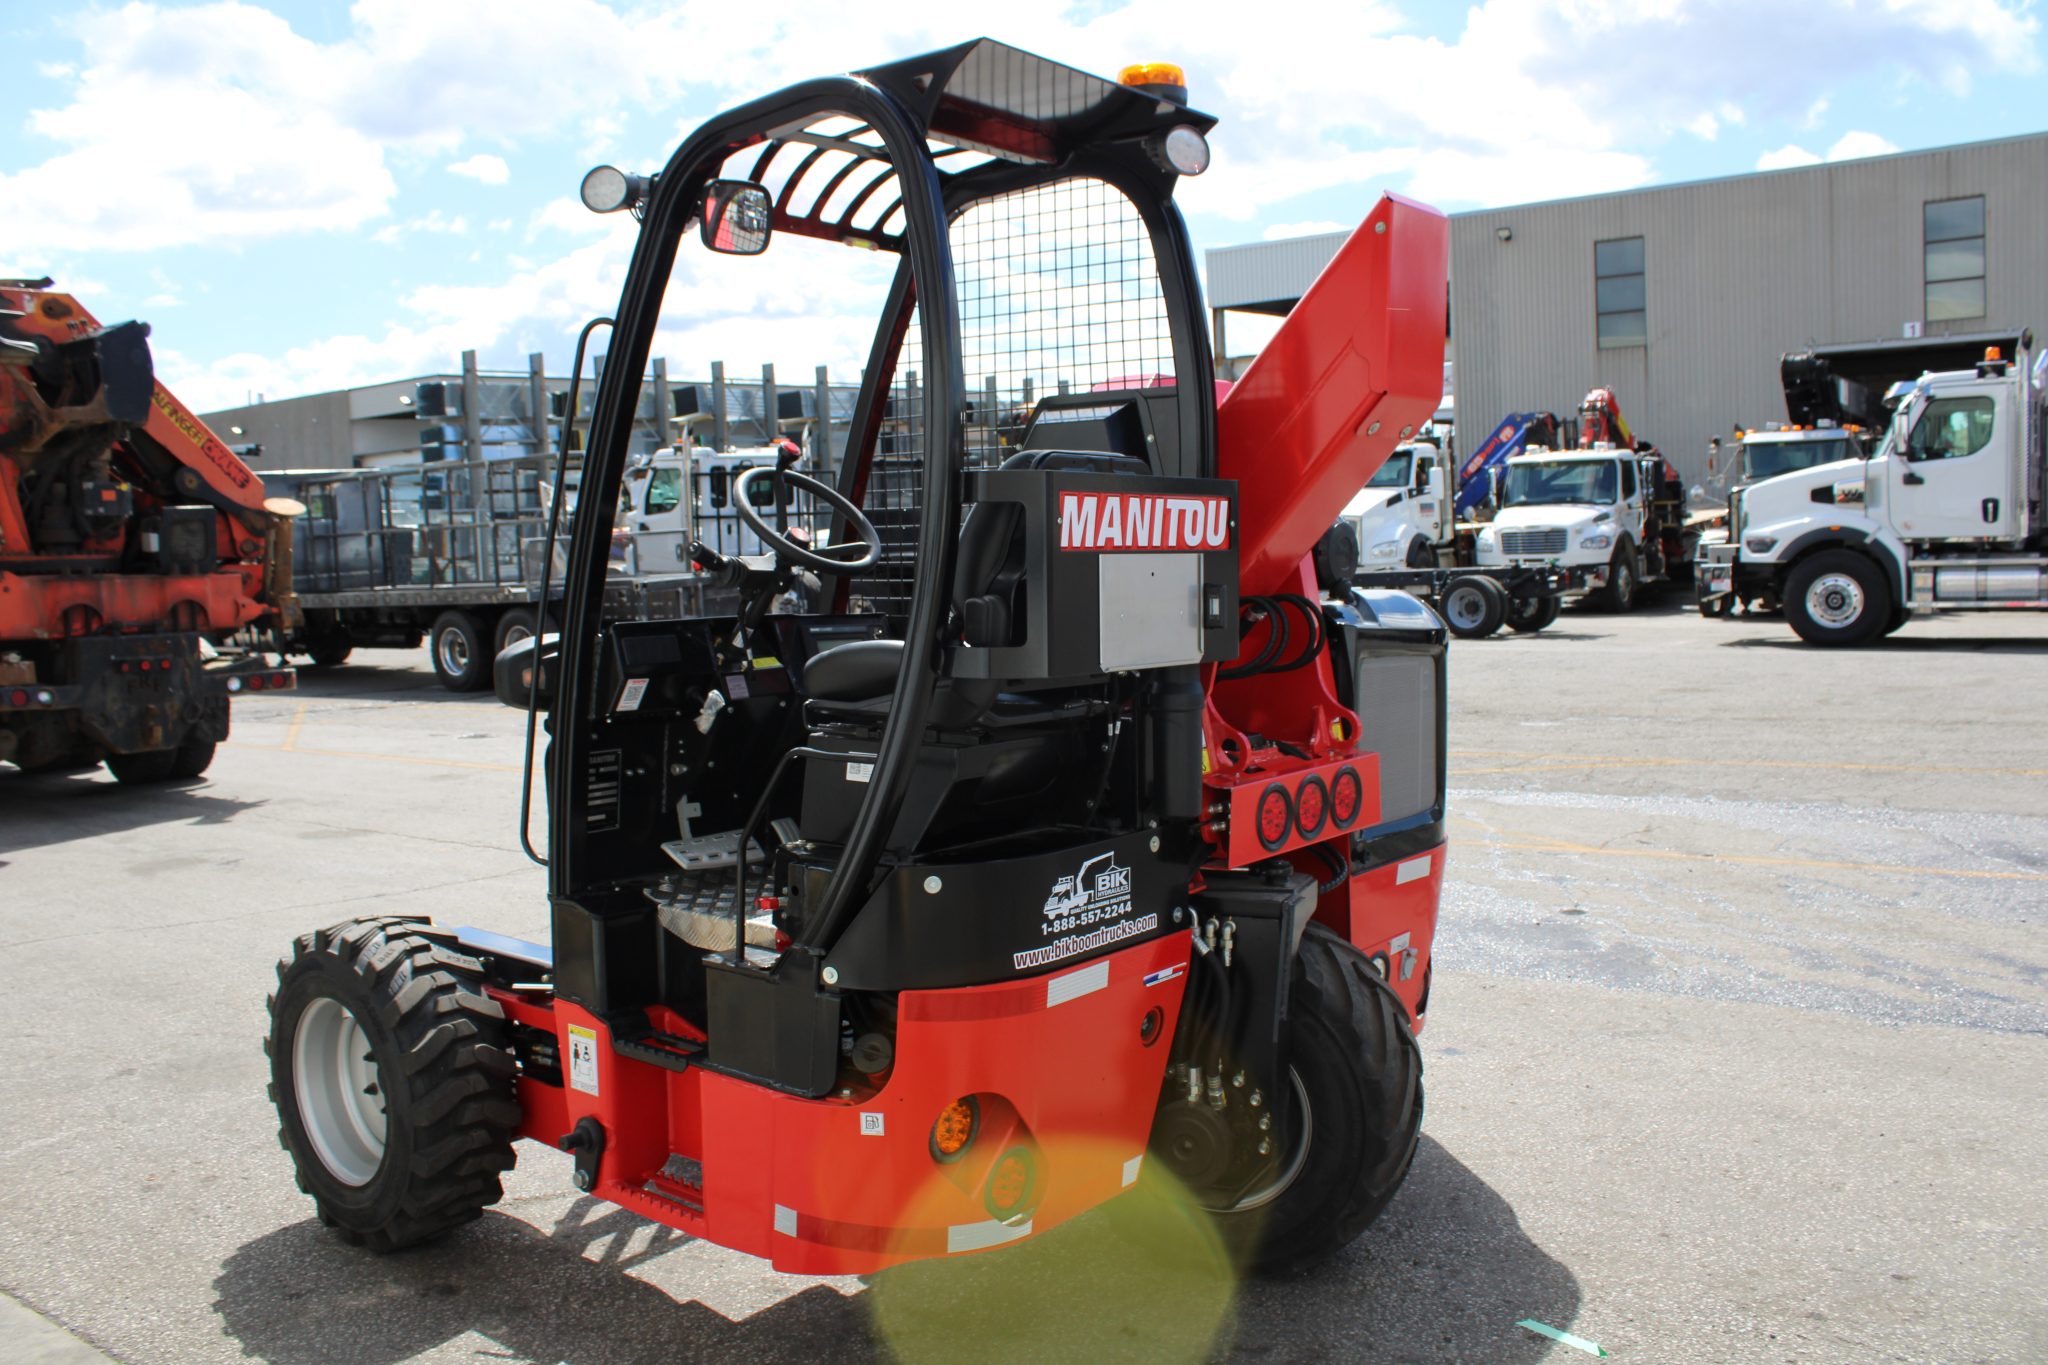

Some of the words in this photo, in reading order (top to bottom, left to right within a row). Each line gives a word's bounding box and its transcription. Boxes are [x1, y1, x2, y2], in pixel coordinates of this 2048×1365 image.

[153, 391, 206, 448] ALFINGER
[1060, 495, 1228, 548] MANITOU
[1097, 884, 1129, 898] HYDRAULICS
[1098, 871, 1128, 891] BIK
[1041, 901, 1132, 935] 1-888-557-2244
[1014, 913, 1157, 969] www.bikboomtrucks.com
